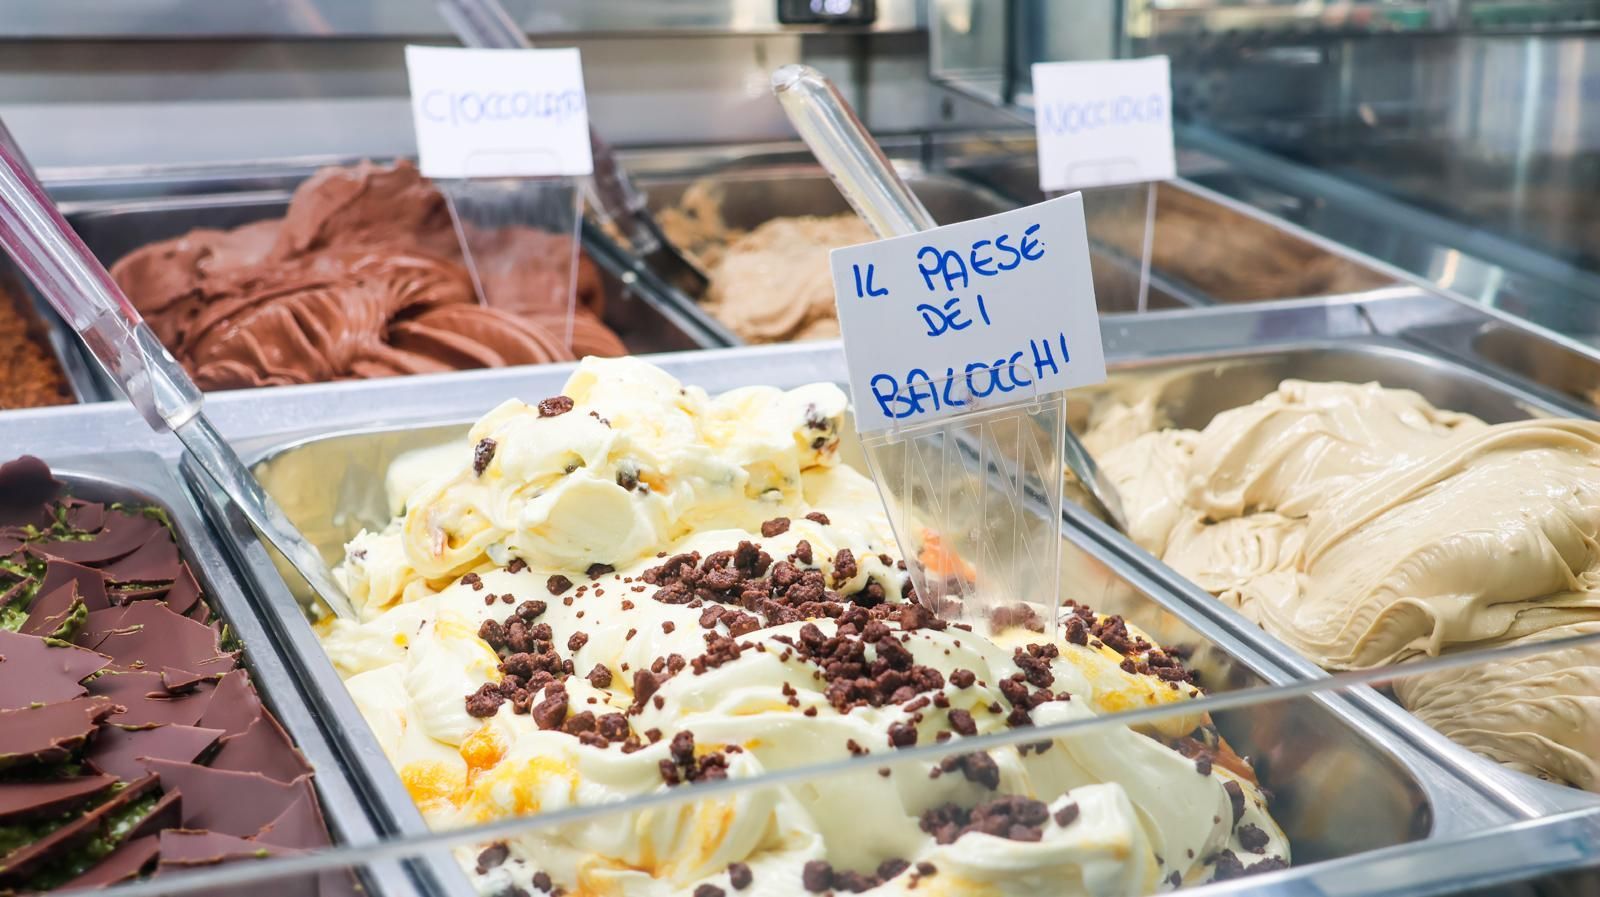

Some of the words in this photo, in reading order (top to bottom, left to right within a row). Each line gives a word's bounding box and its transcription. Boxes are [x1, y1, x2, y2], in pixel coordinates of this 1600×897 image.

[852, 263, 889, 298] IL
[916, 223, 1046, 291] PAESE
[916, 294, 991, 337] DEI
[870, 332, 1070, 419] BALOCCHI
